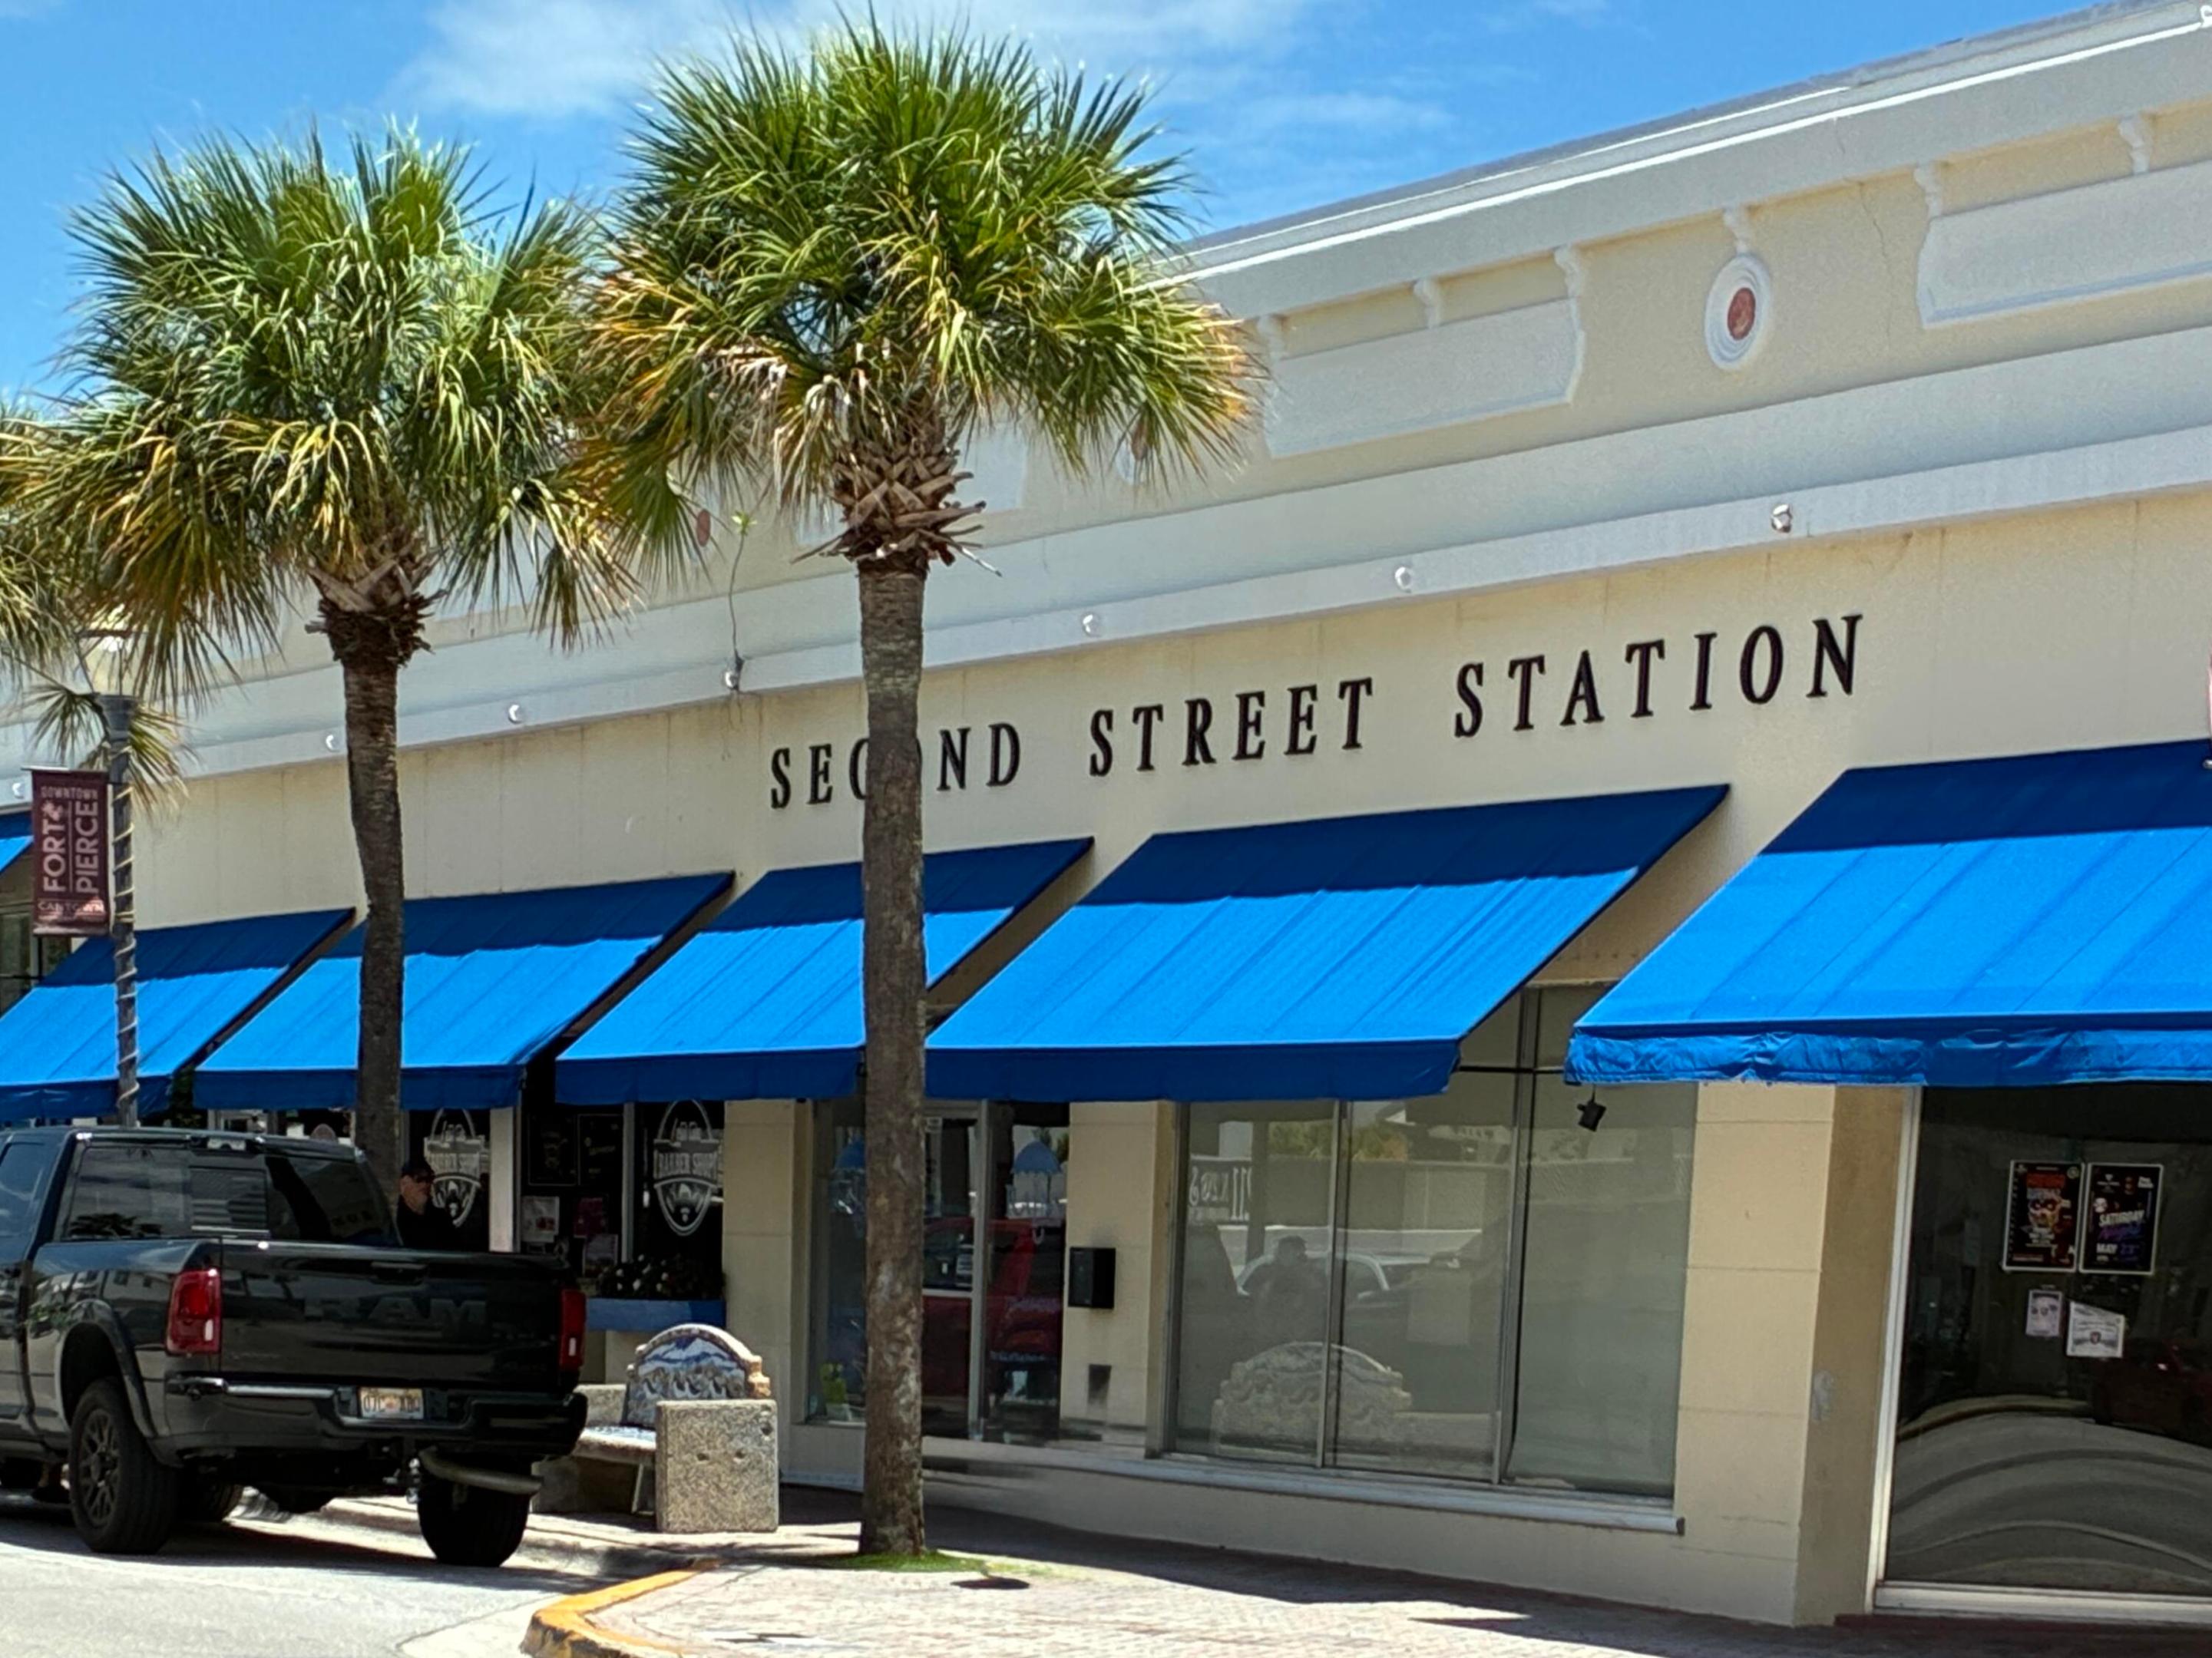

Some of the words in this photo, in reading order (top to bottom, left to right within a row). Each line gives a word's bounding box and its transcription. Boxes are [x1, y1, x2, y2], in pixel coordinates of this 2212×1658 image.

[770, 722, 1020, 809] SECND
[1089, 677, 1373, 777] STREET
[1454, 613, 1863, 738] STATION
[41, 786, 98, 800] DOWNTOWN
[42, 818, 67, 892] FORT
[75, 801, 99, 893] PIERCE
[2098, 1210, 2145, 1227] SATURDAY
